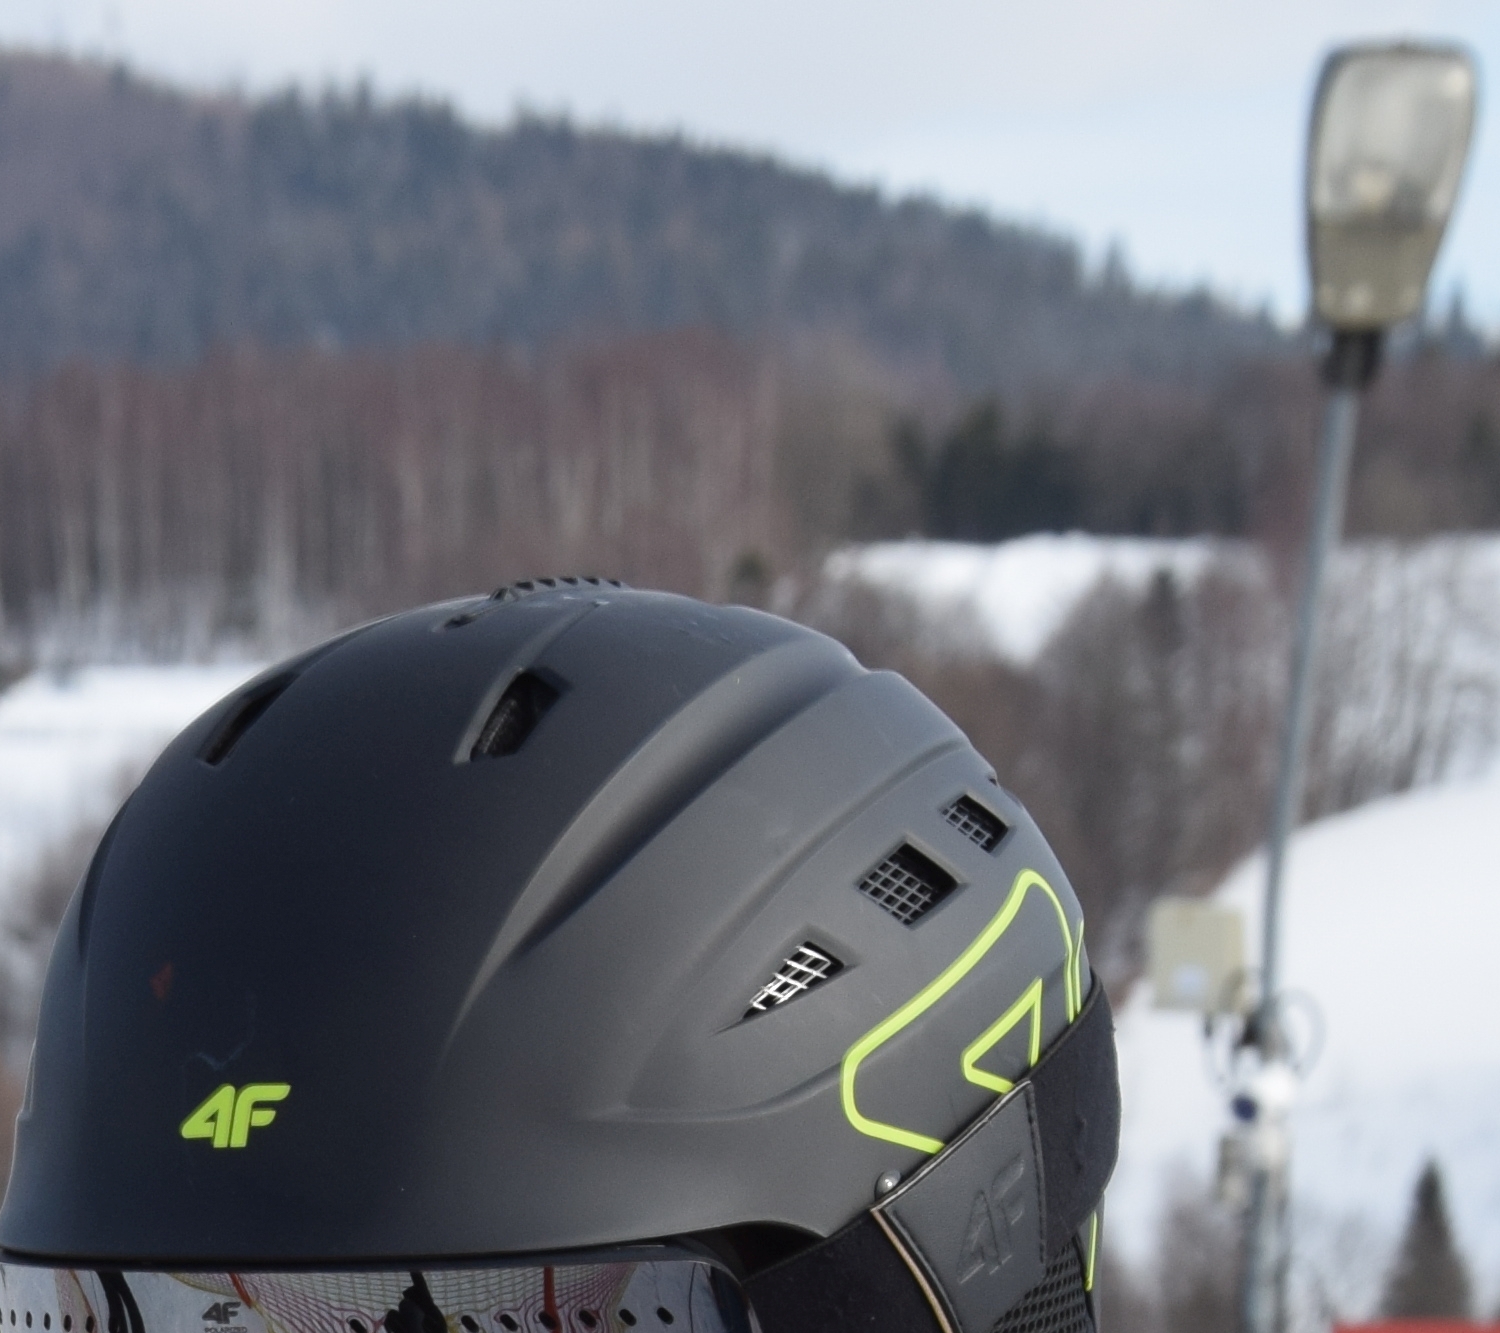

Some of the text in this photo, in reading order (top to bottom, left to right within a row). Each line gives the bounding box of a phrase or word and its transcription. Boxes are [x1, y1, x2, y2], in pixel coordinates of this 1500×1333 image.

[180, 1083, 291, 1149] 4F
[958, 1155, 1024, 1284] 4F
[202, 1301, 241, 1325] 4F
